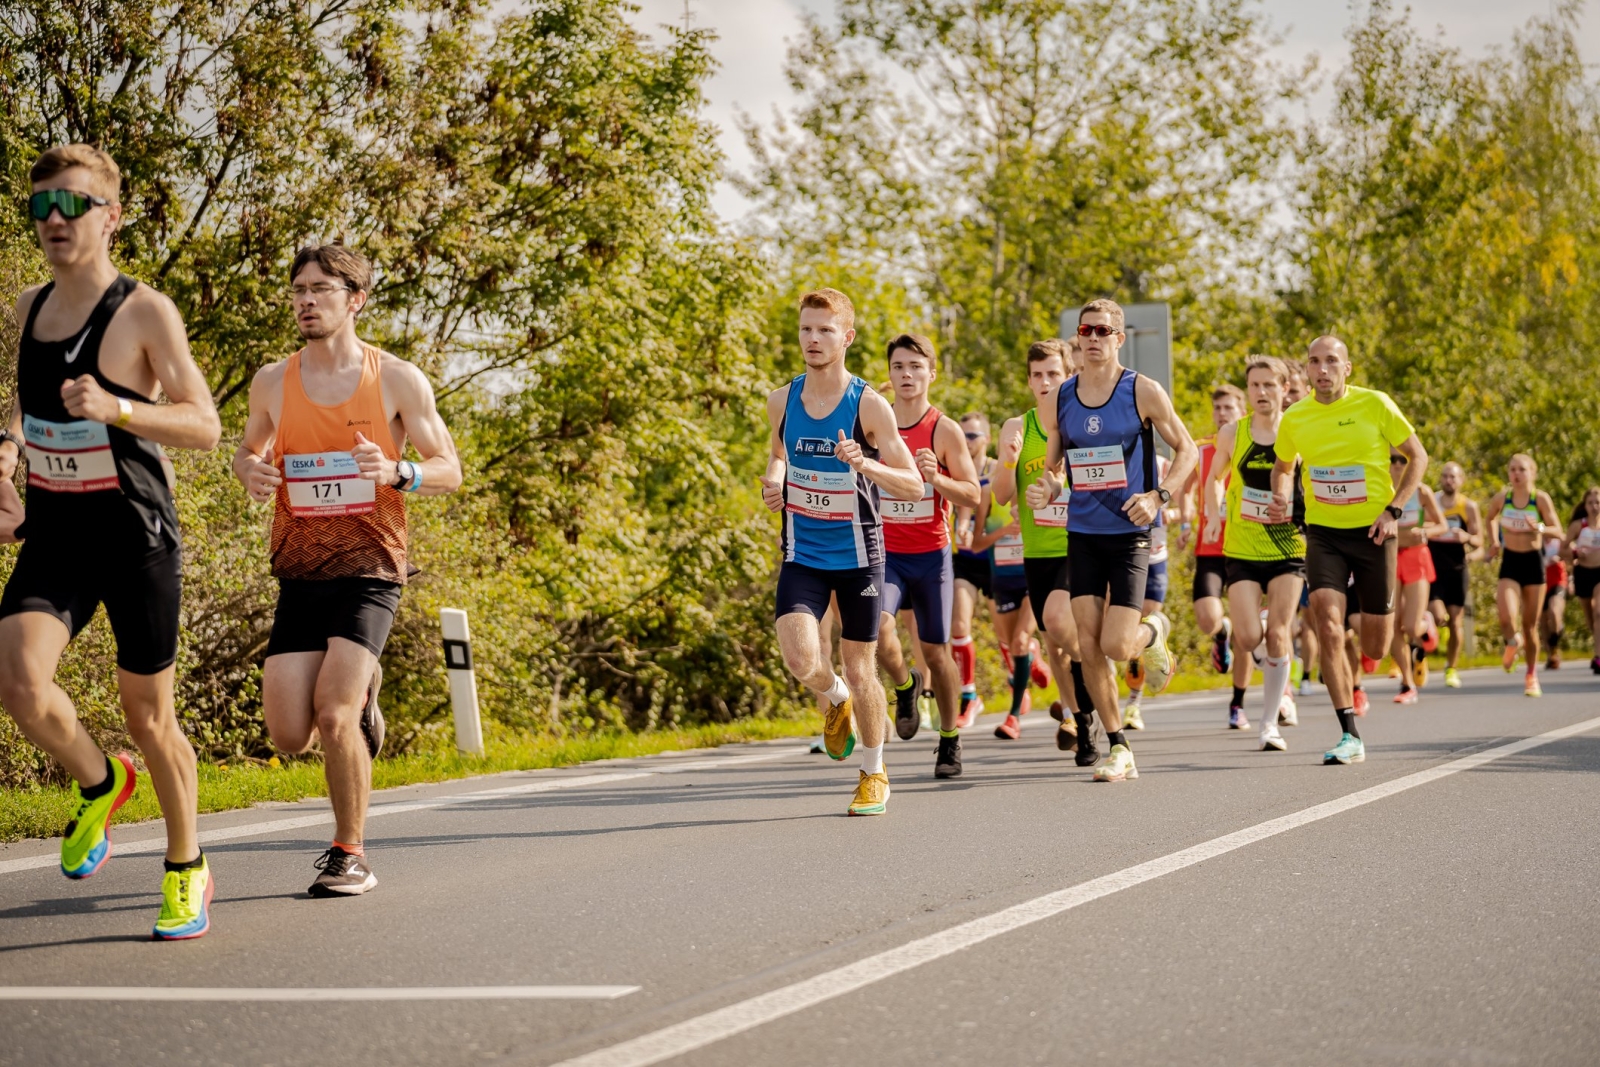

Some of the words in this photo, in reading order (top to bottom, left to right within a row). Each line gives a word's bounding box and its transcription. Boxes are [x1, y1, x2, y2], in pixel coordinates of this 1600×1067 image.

[46, 455, 78, 472] 114
[292, 459, 315, 468] ČESKÁ
[793, 471, 810, 481] ČESKÁ
[1086, 468, 1105, 478] 132
[312, 482, 342, 498] 171
[1327, 485, 1347, 494] 164
[806, 493, 830, 507] 316
[892, 502, 914, 513] 312
[1052, 506, 1066, 516] 17
[1255, 506, 1269, 516] 14
